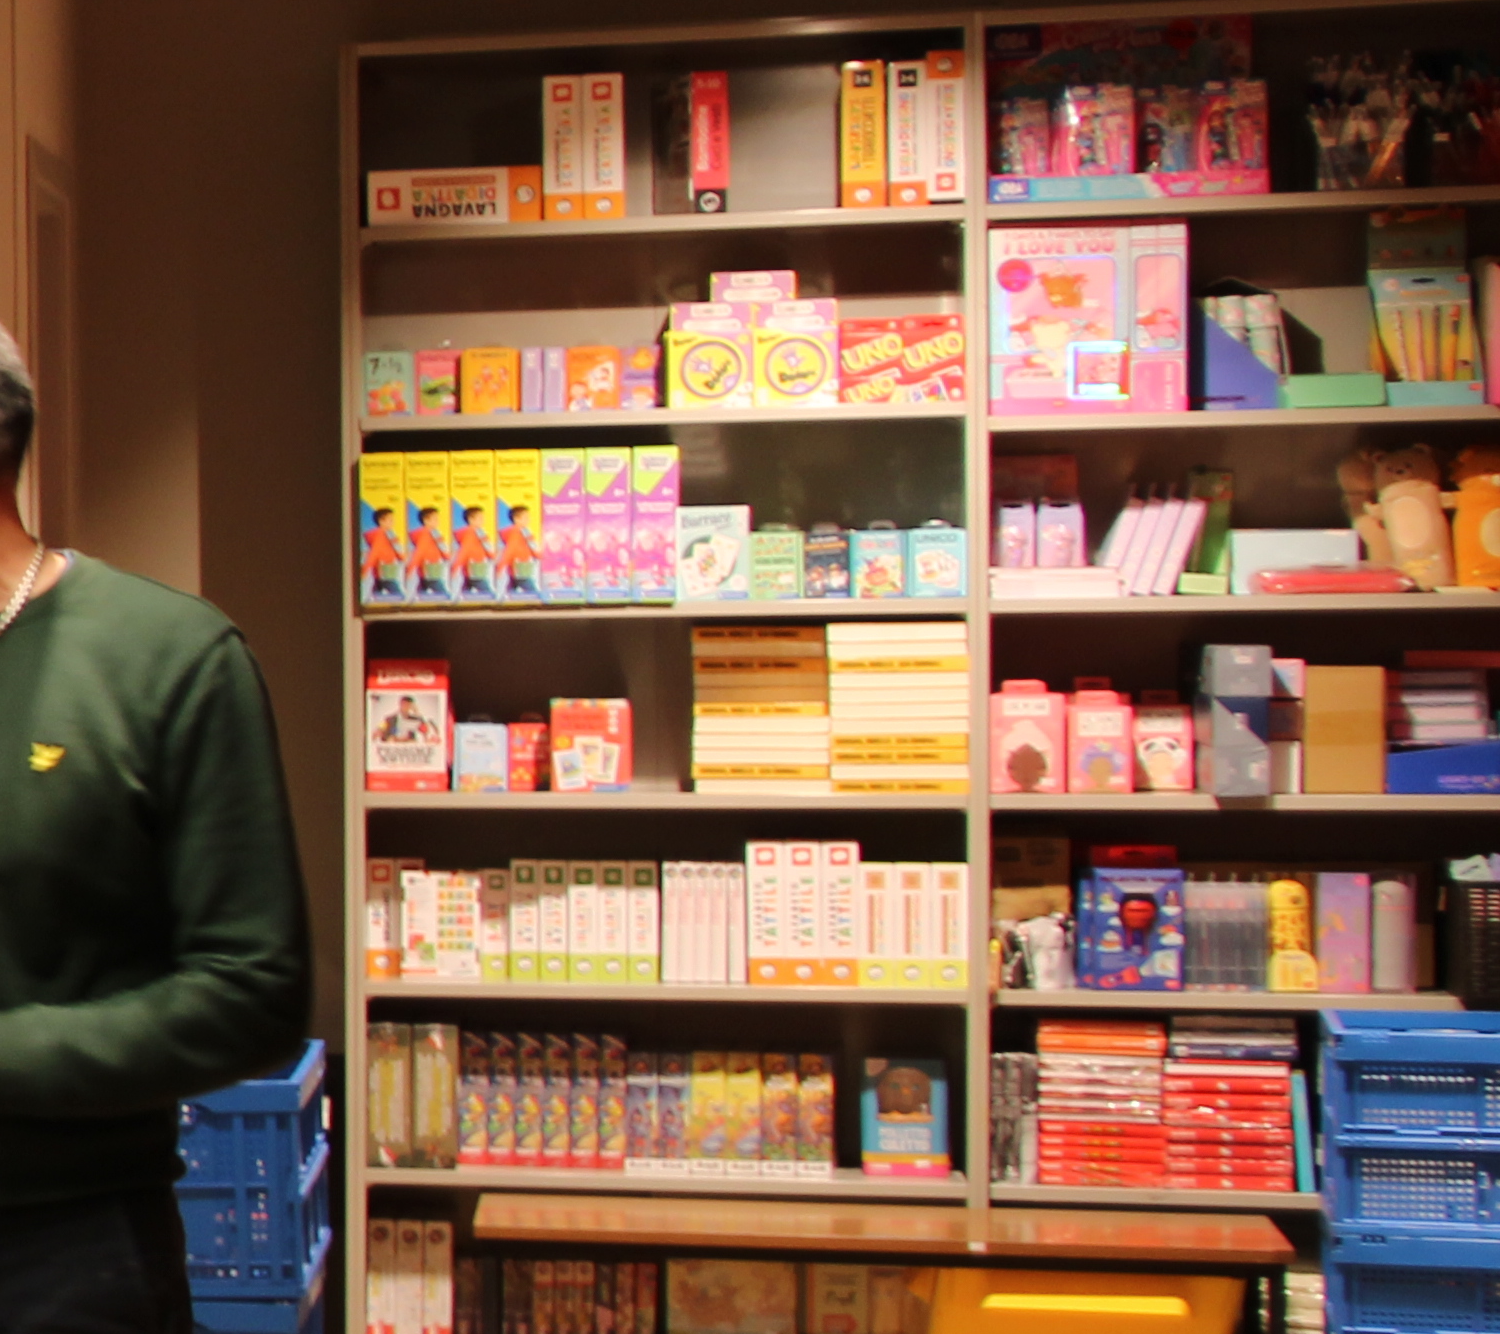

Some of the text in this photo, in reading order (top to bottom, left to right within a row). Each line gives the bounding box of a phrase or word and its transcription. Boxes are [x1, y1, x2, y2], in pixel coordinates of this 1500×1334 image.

[841, 332, 903, 371] UNO
[902, 331, 963, 370] UNO
[763, 877, 777, 947] TATTILE
[800, 877, 814, 947] TATTILE
[837, 877, 851, 947] TATTILE
